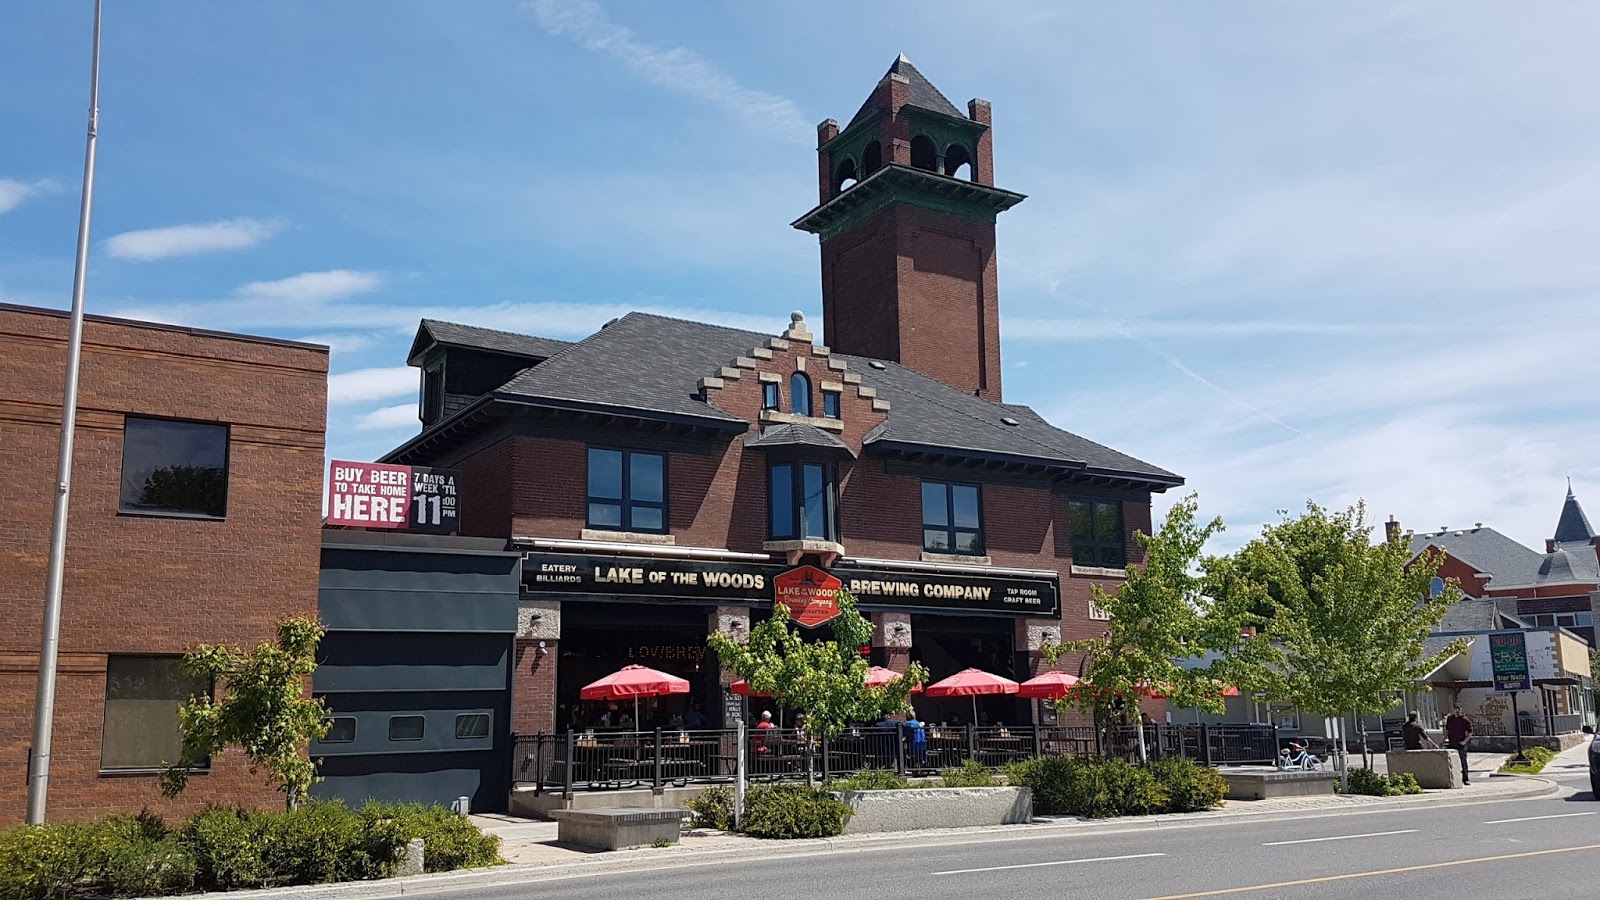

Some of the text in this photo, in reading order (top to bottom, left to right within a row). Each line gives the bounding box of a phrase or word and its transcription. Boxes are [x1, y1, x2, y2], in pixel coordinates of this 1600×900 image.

[335, 467, 407, 486] BUY BEER
[414, 473, 454, 485] 7 DAYS A
[335, 482, 407, 497] TO TAKE HOME
[414, 482, 438, 494] WEEK
[333, 493, 405, 523] HERE
[414, 494, 441, 525] 11
[442, 509, 456, 518] PM
[541, 563, 577, 573] EATERY
[536, 574, 582, 584] BILLIARDS
[595, 566, 764, 590] LAKE OF THE WOODS
[777, 586, 800, 596] LAKE
[850, 579, 991, 601] BREWING COMPANY
[1007, 588, 1037, 597] TAP ROOM
[784, 595, 833, 608] Brewing Company
[1003, 596, 1041, 606] CRAFT BEER
